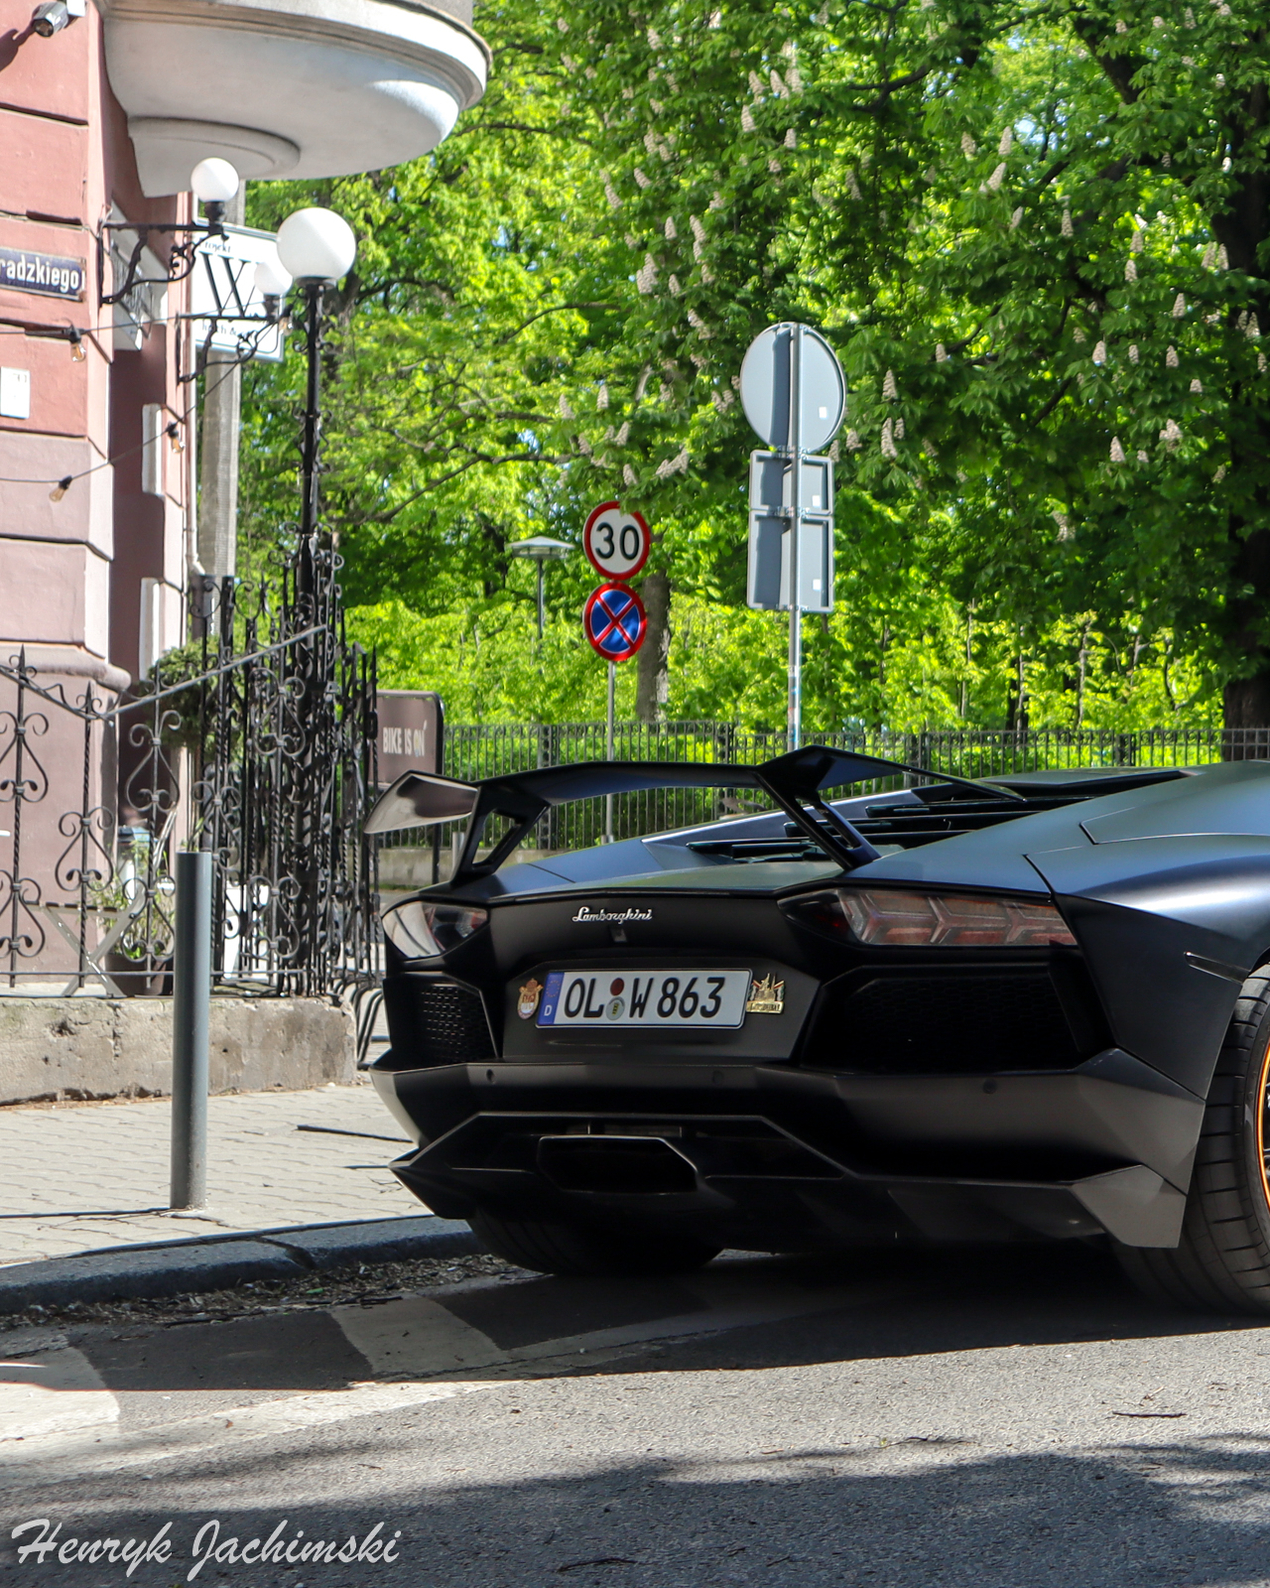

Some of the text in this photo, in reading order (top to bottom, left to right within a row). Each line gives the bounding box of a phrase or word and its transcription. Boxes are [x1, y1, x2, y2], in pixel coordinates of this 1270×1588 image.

[595, 522, 639, 560] 30
[383, 727, 402, 754] BIKE
[404, 728, 412, 756] IS
[572, 906, 653, 925] Lamborghini
[544, 1004, 553, 1016] D
[564, 976, 726, 1018] OL W 863
